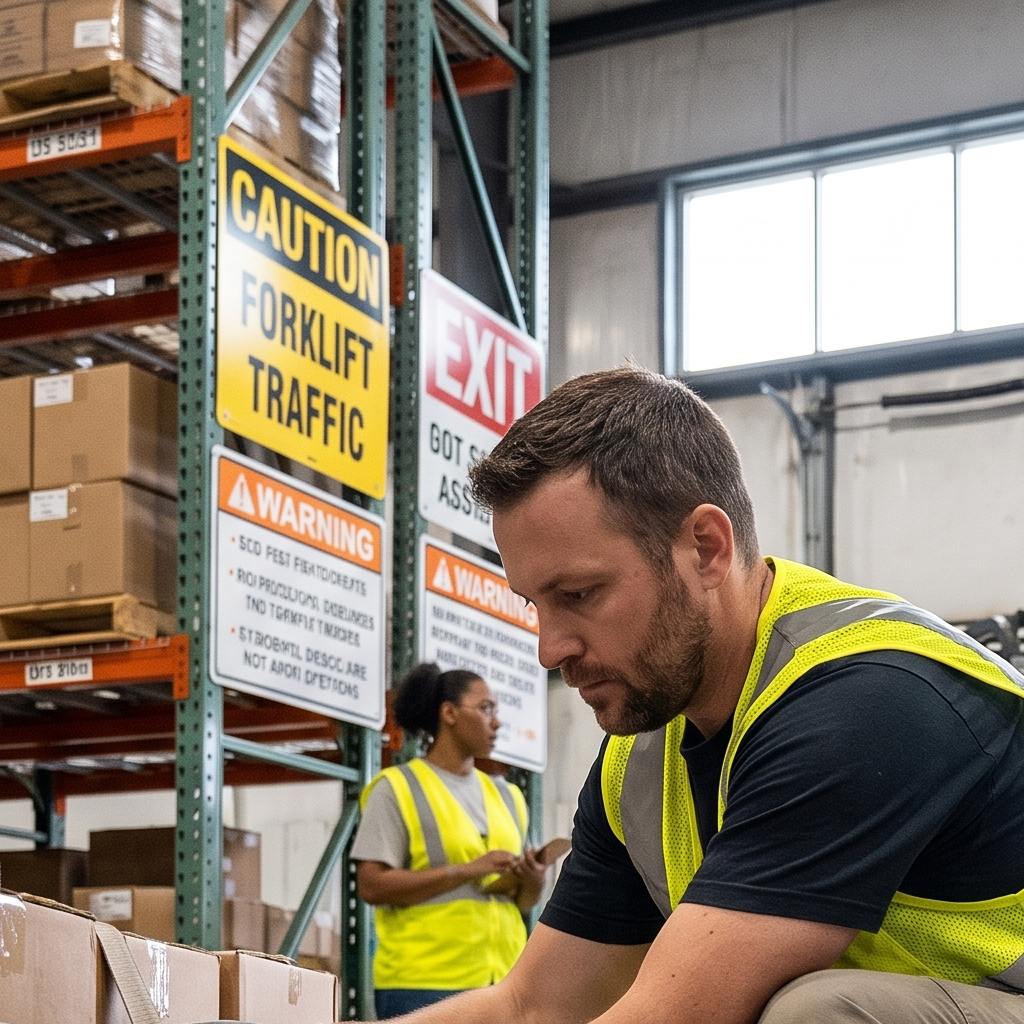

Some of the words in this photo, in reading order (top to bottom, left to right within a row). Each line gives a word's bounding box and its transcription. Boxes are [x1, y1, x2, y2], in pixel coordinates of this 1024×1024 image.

[231, 168, 380, 310] CAUTION
[241, 269, 373, 390] FORKLIFT
[435, 299, 533, 426] EXIT
[248, 354, 364, 462] TRAFFIC
[430, 422, 463, 466] GOT
[256, 482, 374, 562] WARNING
